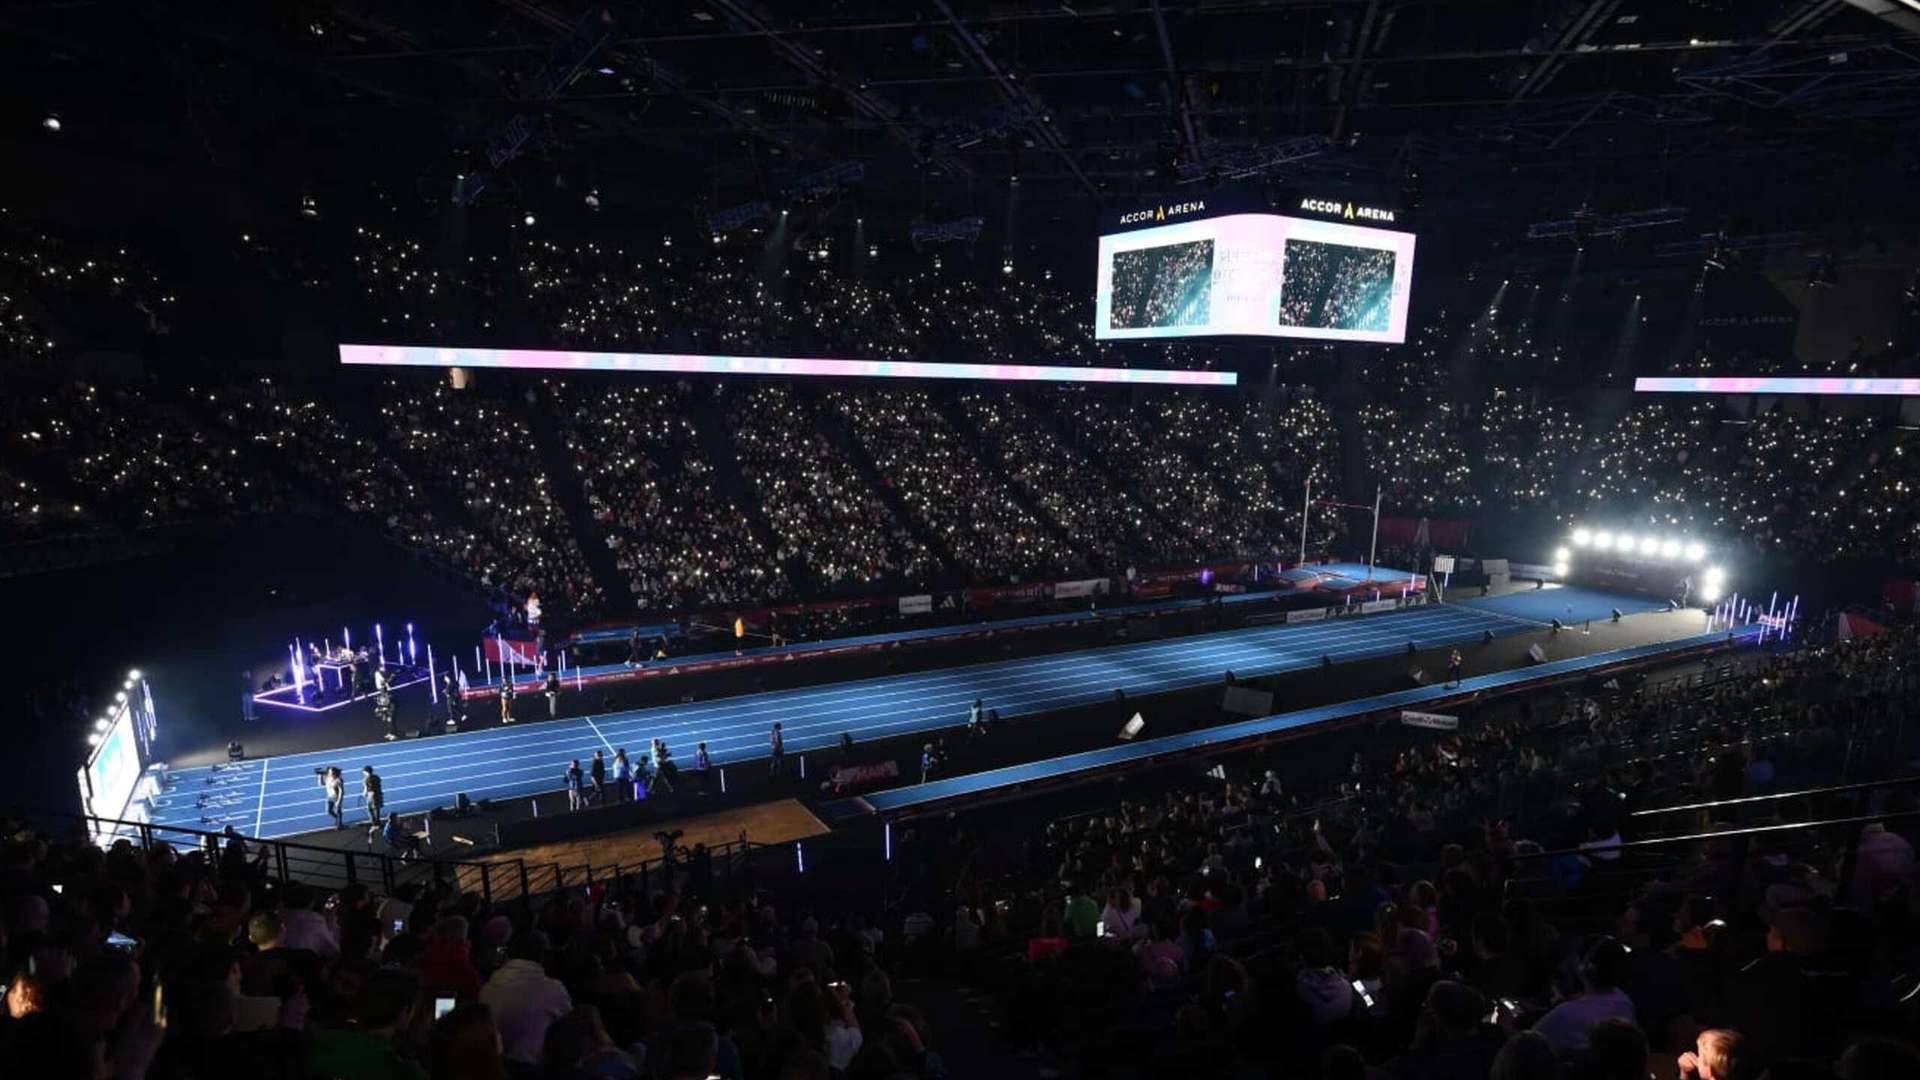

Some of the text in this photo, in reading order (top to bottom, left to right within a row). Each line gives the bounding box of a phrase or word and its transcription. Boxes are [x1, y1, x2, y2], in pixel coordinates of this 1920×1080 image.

[1120, 209, 1154, 225] ACCOR
[1168, 200, 1206, 216] ARENA
[1300, 198, 1342, 215] ACCOR
[1356, 206, 1395, 222] ARENA
